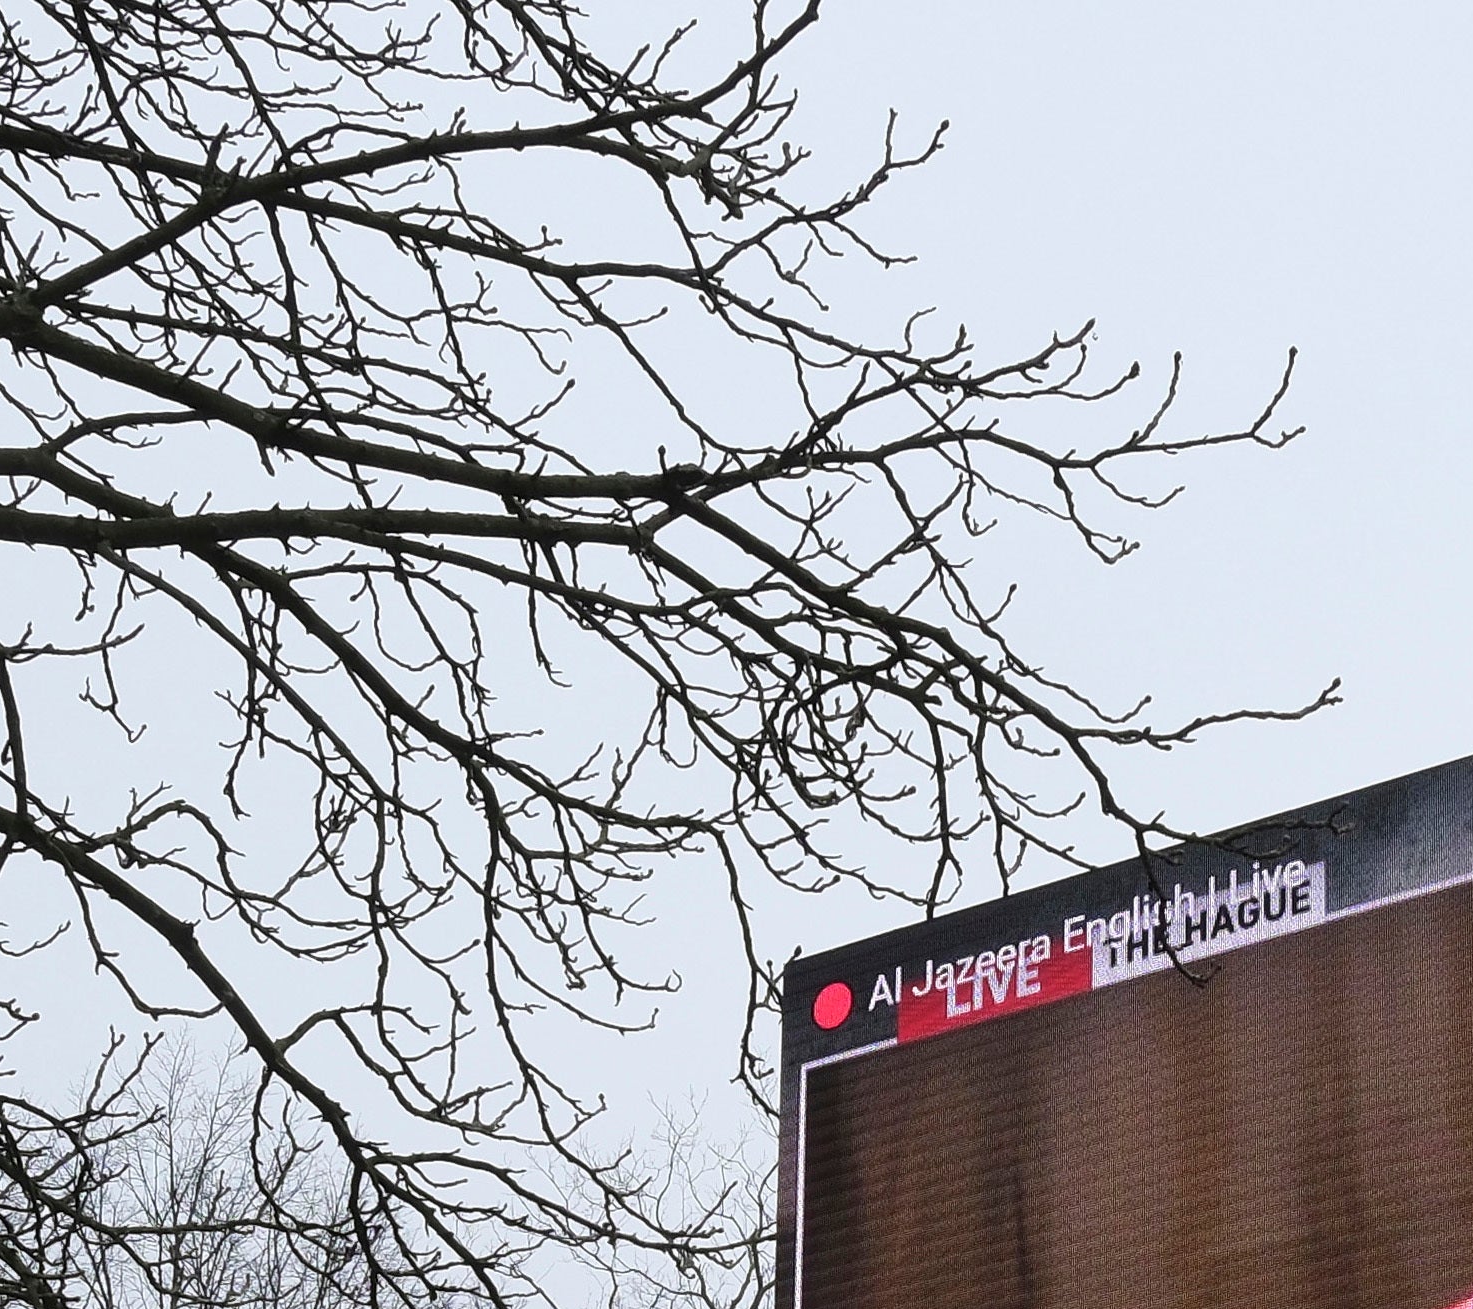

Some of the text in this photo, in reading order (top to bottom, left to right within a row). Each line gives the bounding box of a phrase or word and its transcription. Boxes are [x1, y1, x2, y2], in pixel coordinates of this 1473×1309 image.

[868, 969, 902, 1012] Al
[912, 933, 1051, 997] Jazeera
[1229, 859, 1307, 901] Live
[946, 957, 1041, 1018] LIVE
[1185, 881, 1313, 947] HAGUE
